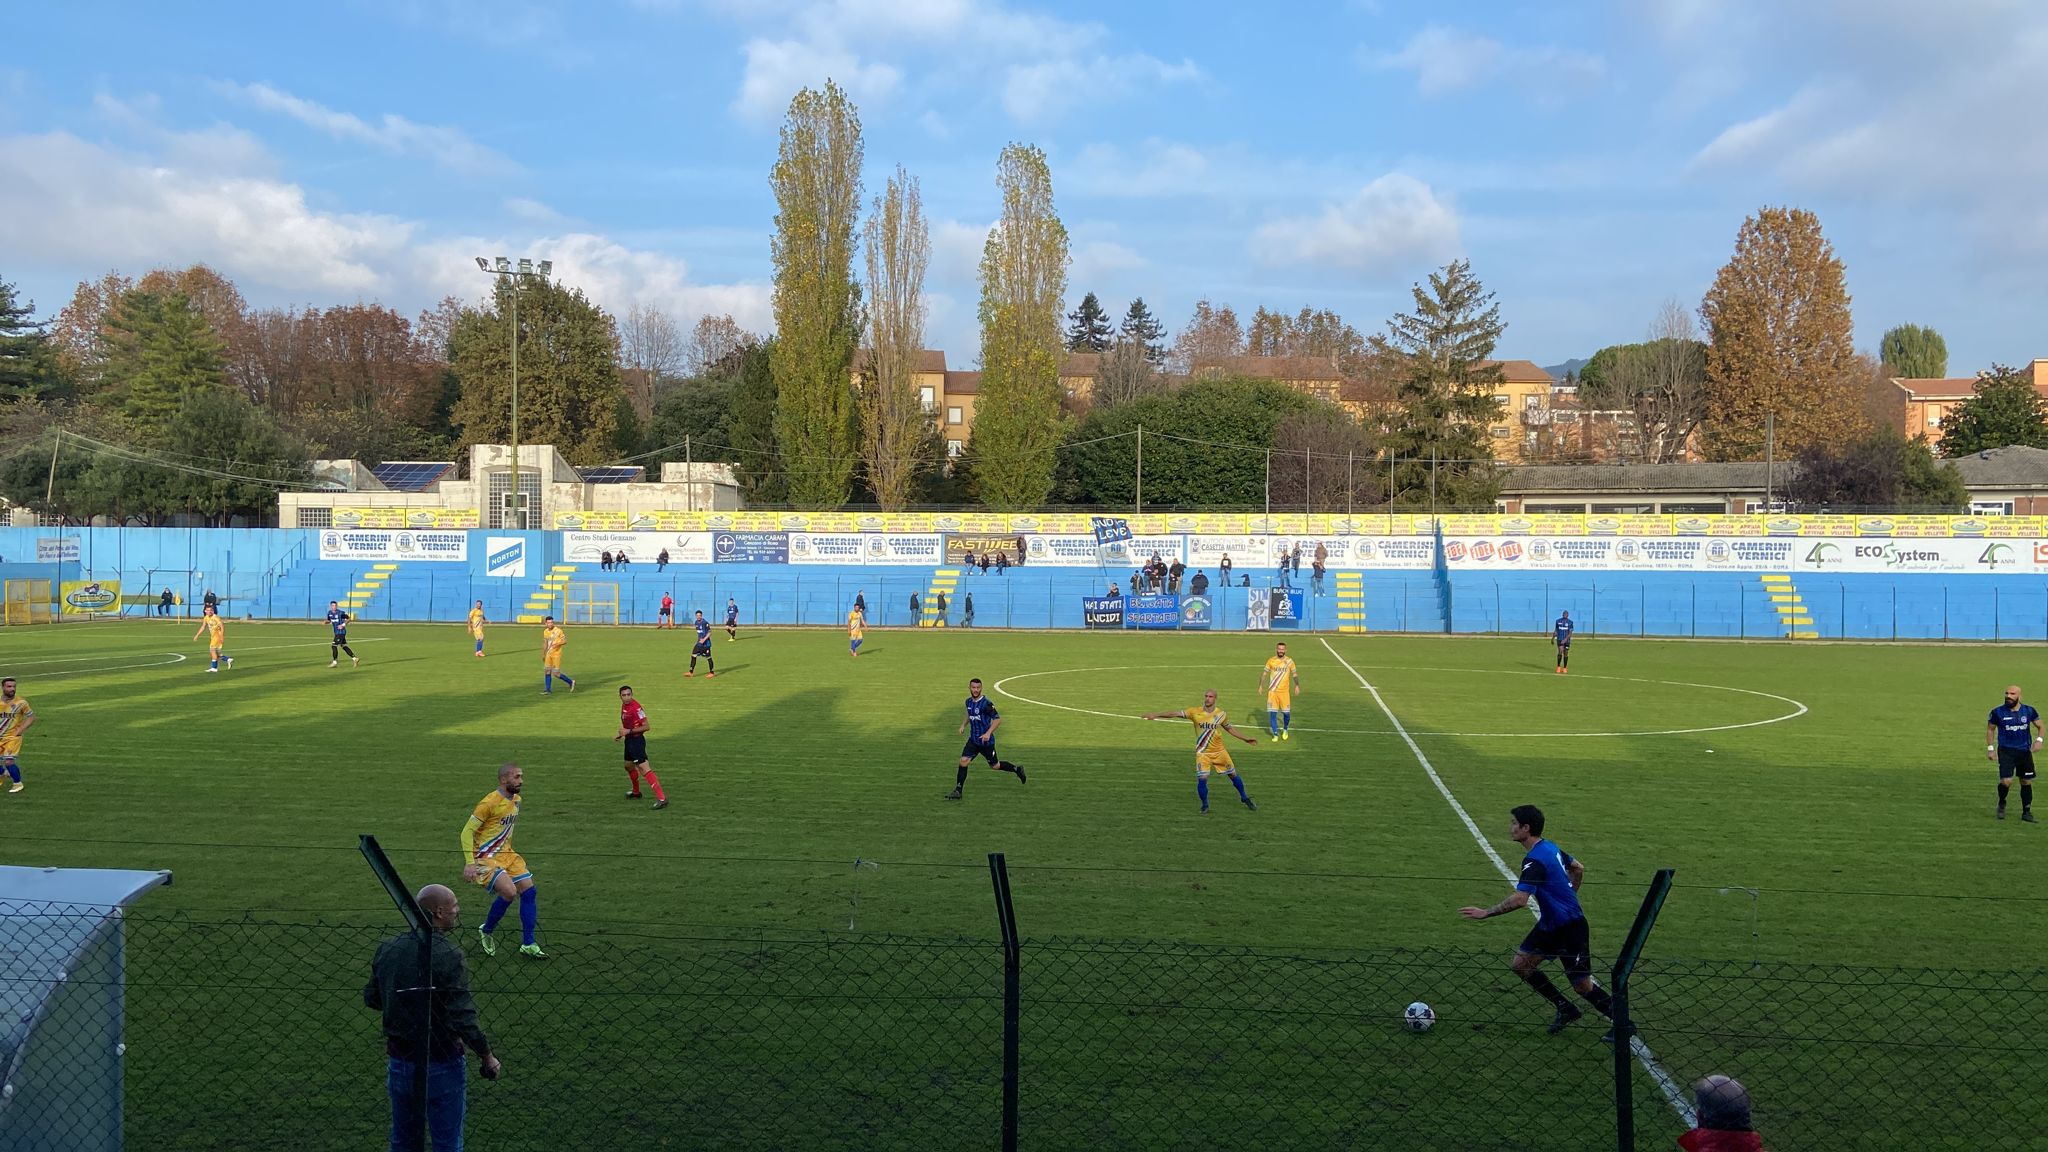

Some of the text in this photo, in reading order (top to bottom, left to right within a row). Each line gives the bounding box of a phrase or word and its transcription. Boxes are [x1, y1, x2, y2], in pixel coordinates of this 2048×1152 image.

[1447, 542, 1467, 560] IDEA
[1470, 542, 1495, 560] FIDEA
[1498, 542, 1523, 560] FIDEA
[1641, 542, 1700, 550] CAMERINI
[1731, 542, 1792, 551] CAMERINI
[492, 548, 520, 566] NORTON
[1737, 552, 1785, 560] VERNICI
[1100, 600, 1121, 610] STATI
[1087, 612, 1120, 623] LUCIDI
[1127, 612, 1177, 623] SPARTACO
